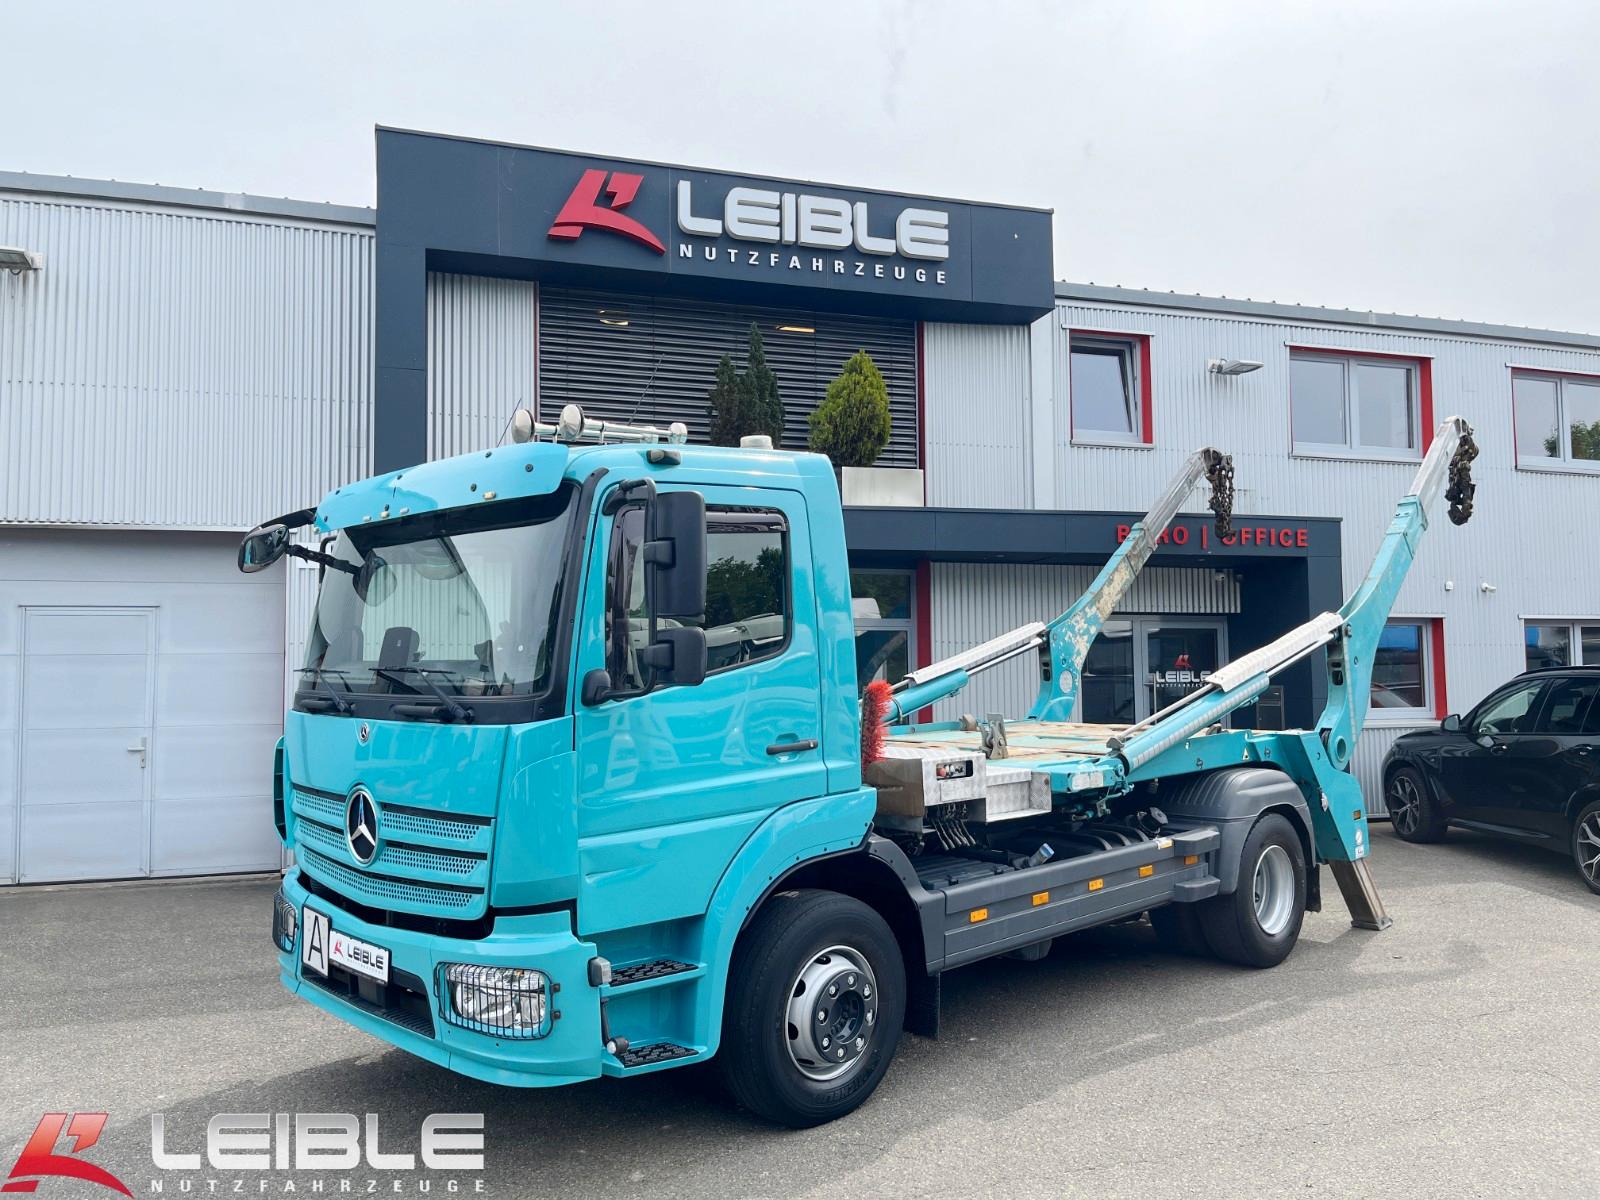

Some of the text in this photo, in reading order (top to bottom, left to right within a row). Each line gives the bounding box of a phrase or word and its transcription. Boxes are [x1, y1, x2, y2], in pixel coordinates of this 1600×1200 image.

[677, 179, 949, 261] LEIBLE
[678, 243, 946, 284] NUTZFAHRZEUGE
[308, 915, 324, 970] A
[347, 943, 384, 970] LEIBLE
